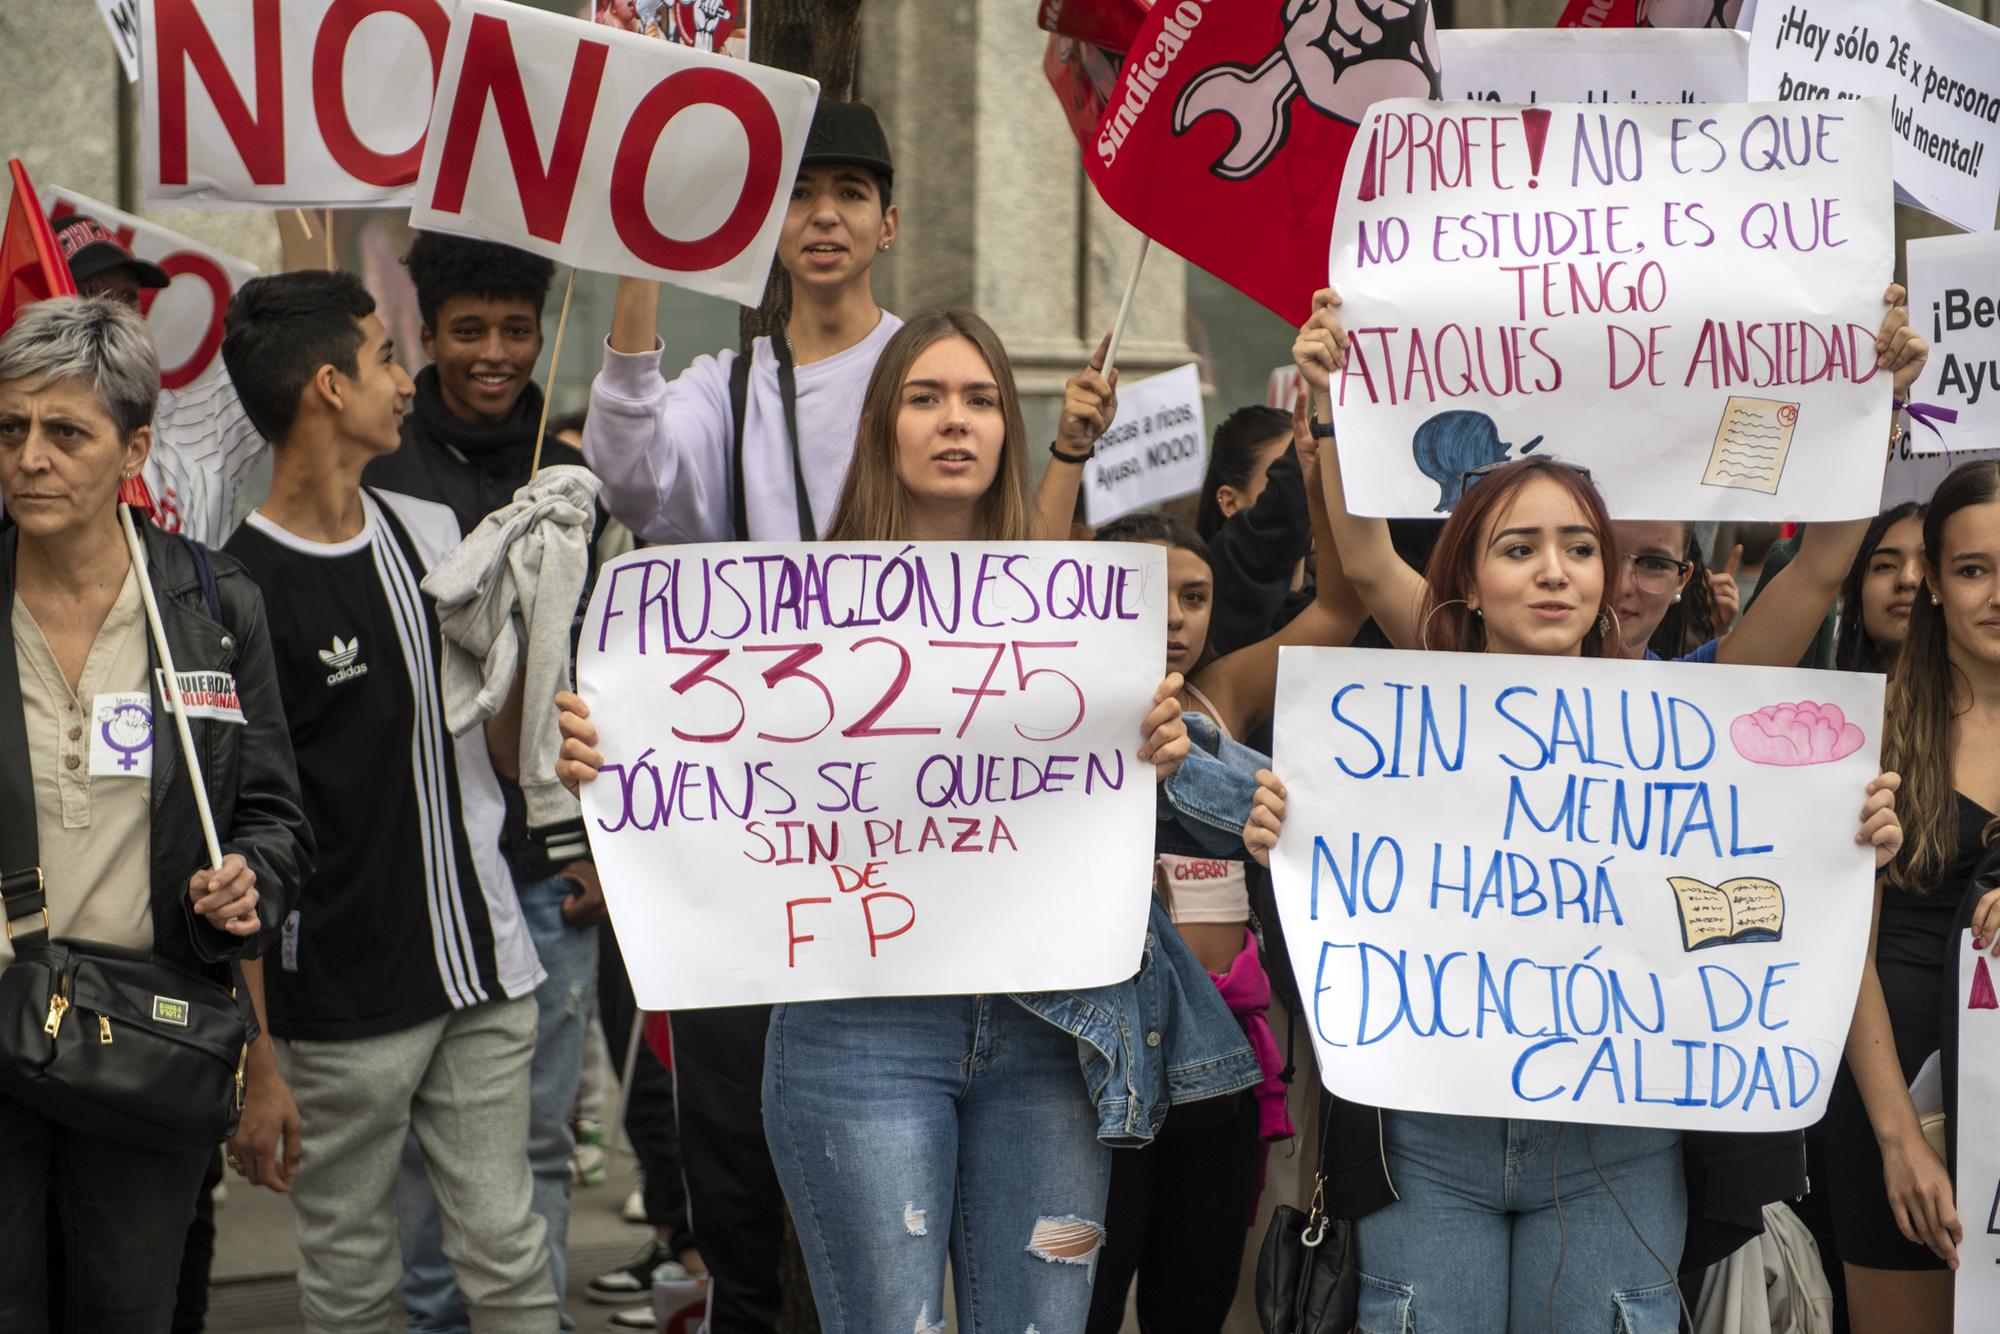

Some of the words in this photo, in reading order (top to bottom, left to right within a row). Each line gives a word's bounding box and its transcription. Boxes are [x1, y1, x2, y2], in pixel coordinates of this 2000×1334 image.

[153, 0, 451, 187] NO
[1098, 0, 1203, 168] Sindicato
[1776, 6, 1830, 62] ¡Hay
[1834, 25, 1879, 63] sólo
[1886, 35, 1910, 76] 2€
[1910, 60, 1922, 87] x
[1922, 65, 2000, 123] persona
[431, 13, 783, 272] NO
[1357, 107, 1552, 202] ¡PROFE!
[1571, 112, 1643, 188] NO
[1671, 117, 1726, 174] ES
[1740, 113, 1844, 172] QUE
[1892, 94, 1913, 141] lud
[1913, 123, 1984, 177] mental!
[1356, 216, 1410, 268] NO
[1432, 206, 1646, 264] ESTUDIE,
[1664, 203, 1715, 249] ES
[1740, 197, 1848, 252] QUE
[1499, 259, 1667, 321] TENGO
[1933, 288, 2000, 343] ¡Be
[1339, 322, 1562, 406] ATAQUES
[1608, 324, 1672, 390] DE
[1684, 318, 1878, 389] ANSIEDAD
[1143, 416, 1153, 434] a
[599, 544, 962, 655] FRUSTRACIÓN
[972, 554, 1041, 632] ES
[1046, 558, 1140, 620] QUE
[327, 663, 368, 686] adidas
[665, 636, 1086, 743] 33275
[1331, 682, 1468, 779] SIN
[1495, 686, 1717, 772] SALUD
[598, 748, 797, 833] JÓVENS
[816, 761, 880, 814] SE
[916, 748, 1124, 811] QUEDEN
[1503, 775, 1774, 858] MENTAL
[743, 820, 838, 866] SIN
[865, 815, 1018, 860] PLAZA
[830, 861, 888, 894] DE
[1174, 860, 1229, 881] CHERRY
[1310, 832, 1404, 921] NO
[1430, 843, 1624, 927] HABRÁ
[1314, 941, 1665, 1047] EDUCACIÓN
[1698, 962, 1799, 1032] DE
[1511, 1037, 1820, 1112] CALIDAD
